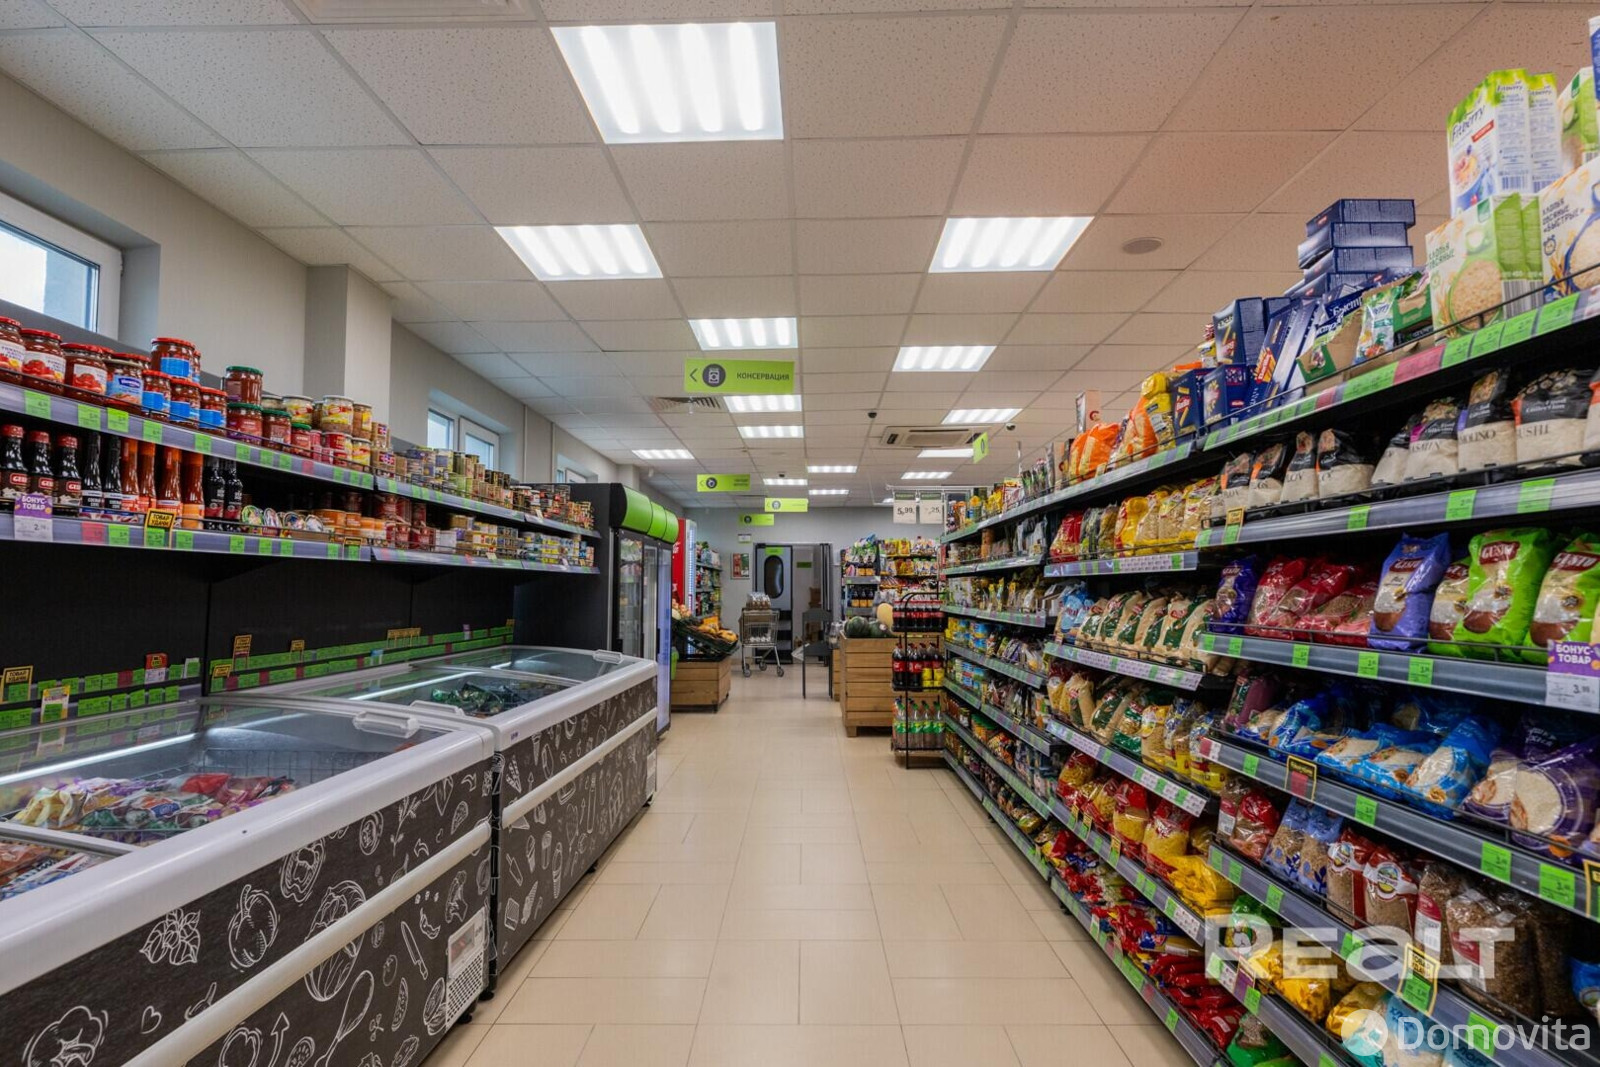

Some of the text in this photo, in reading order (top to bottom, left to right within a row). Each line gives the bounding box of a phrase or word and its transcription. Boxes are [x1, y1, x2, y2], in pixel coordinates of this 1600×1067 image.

[1452, 106, 1485, 142] Fitberry
[736, 372, 790, 381] КОНСЕРВАЦИЯ
[22, 496, 48, 505] БОНУС-
[22, 503, 46, 511] ТОВАР
[153, 513, 170, 521] ТОВАР
[1555, 644, 1594, 655] БОНУС-
[1557, 653, 1592, 665] ТОВАР
